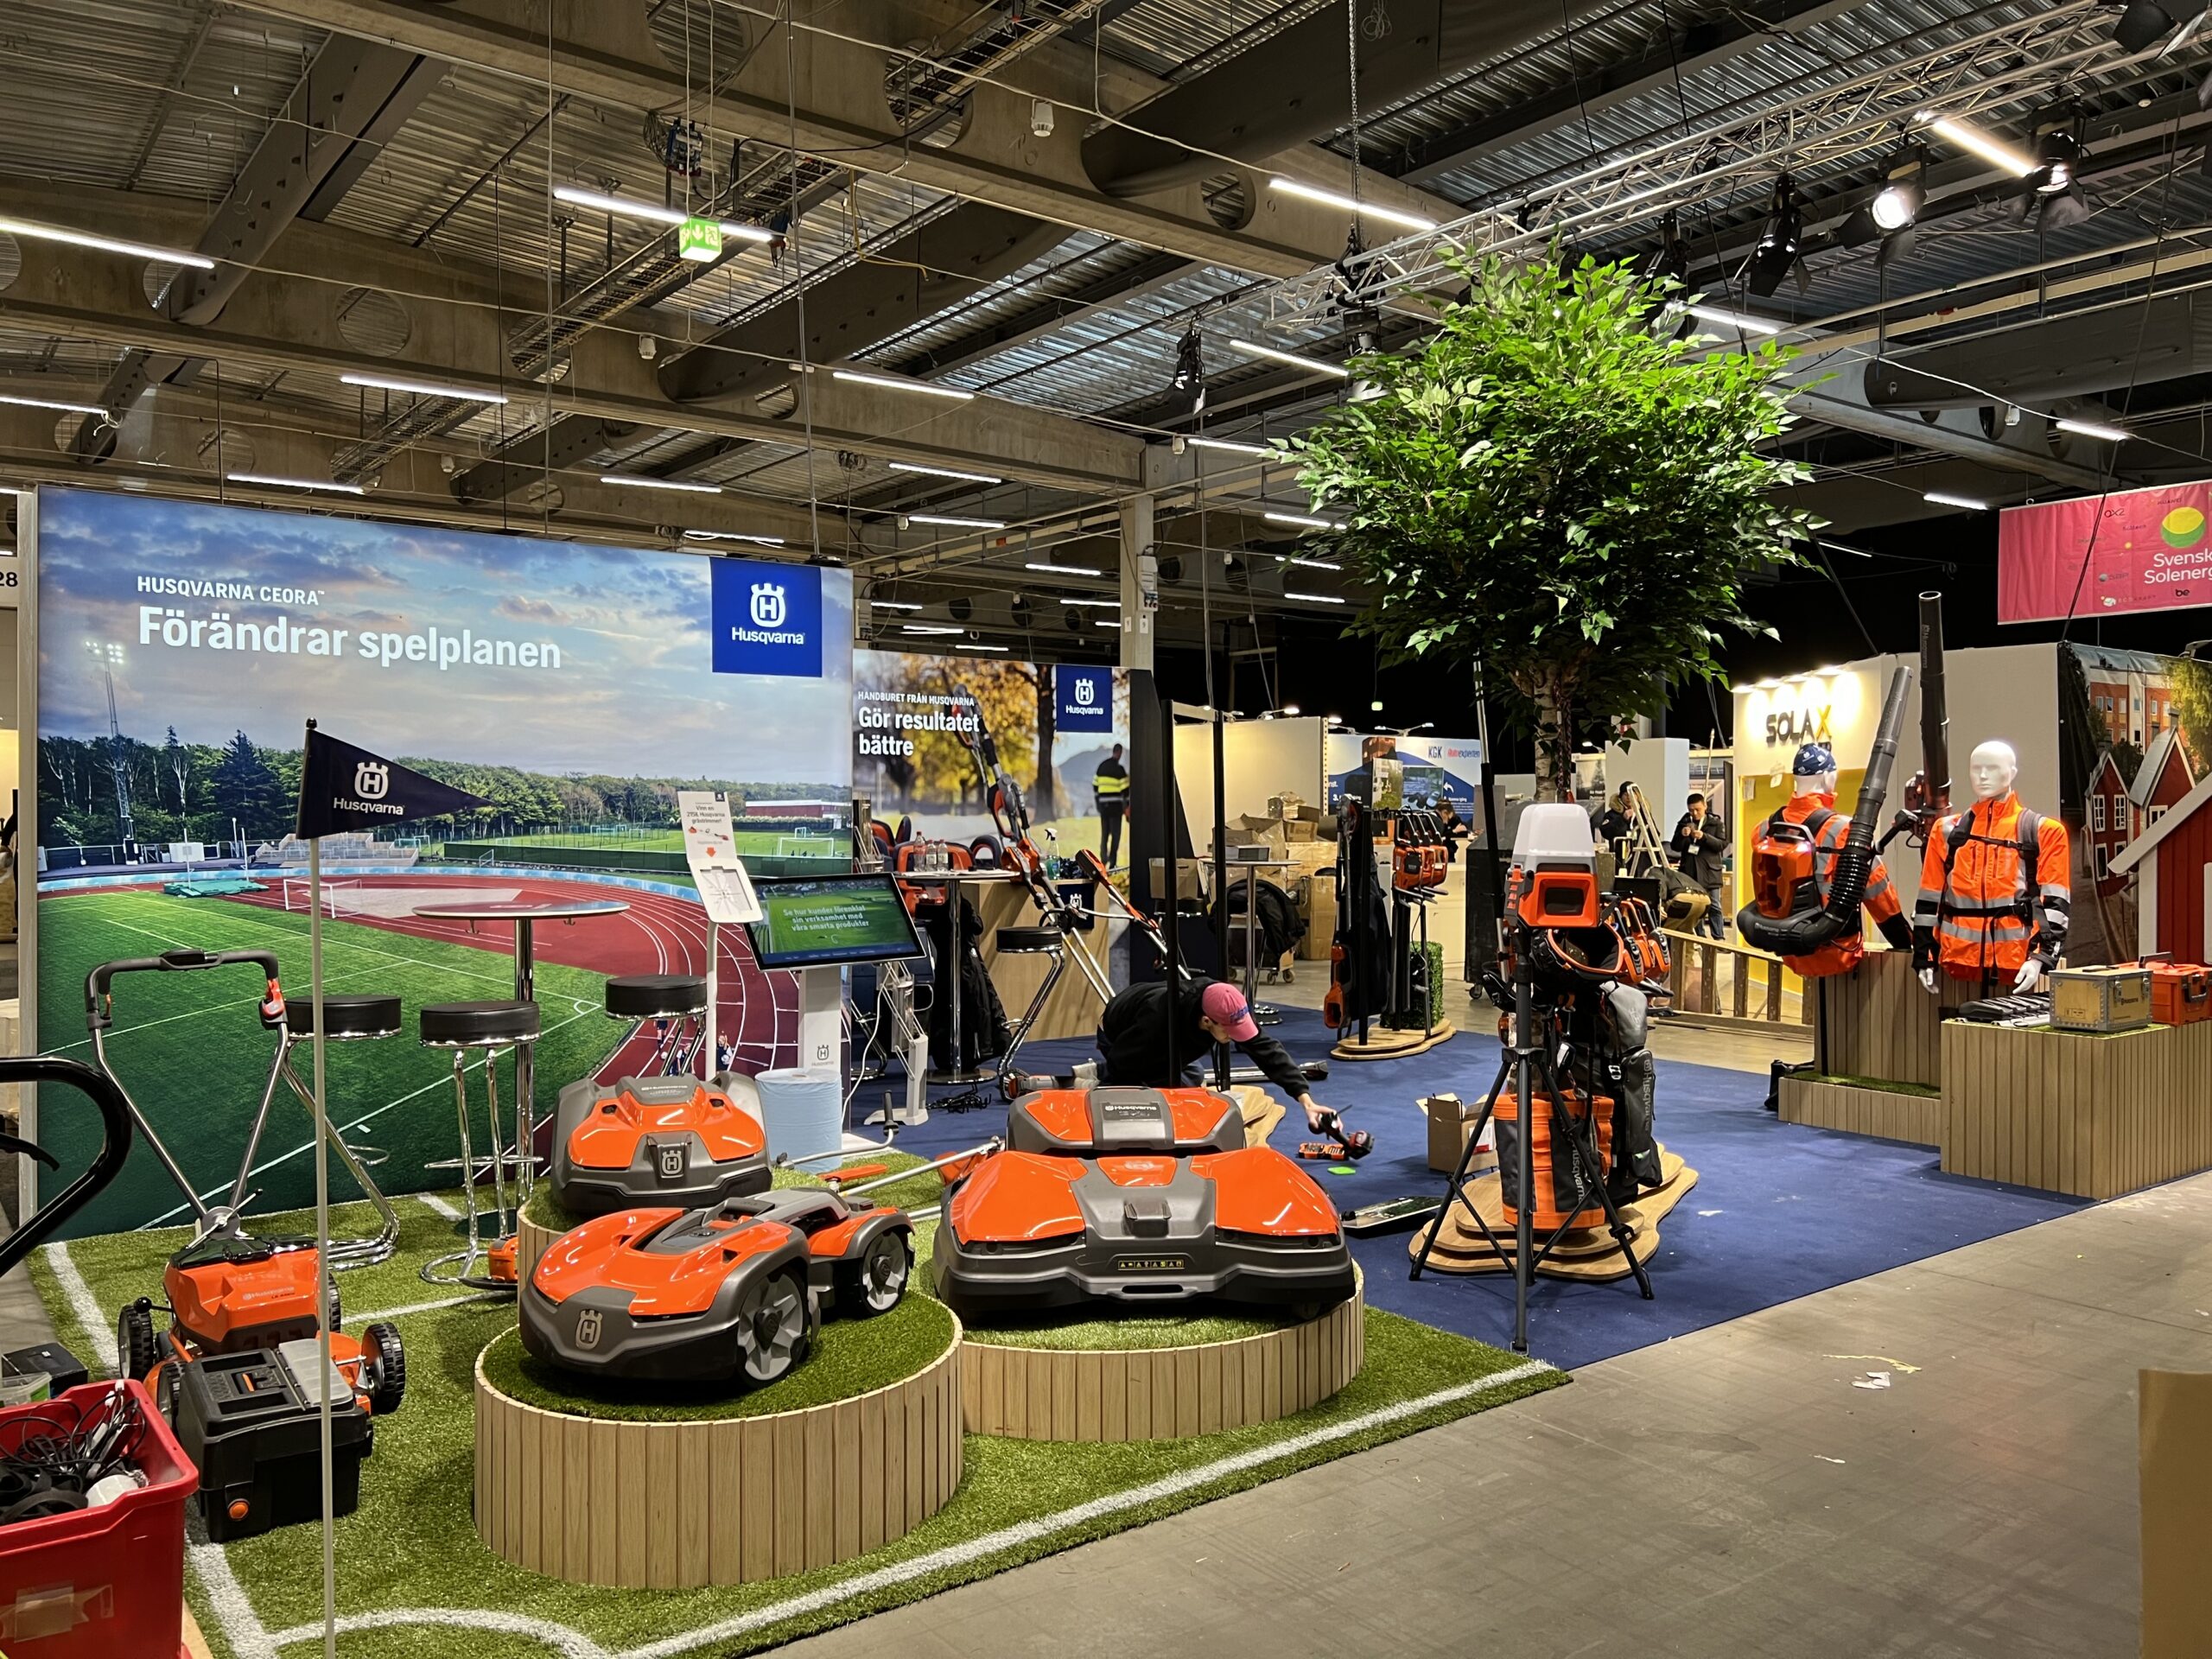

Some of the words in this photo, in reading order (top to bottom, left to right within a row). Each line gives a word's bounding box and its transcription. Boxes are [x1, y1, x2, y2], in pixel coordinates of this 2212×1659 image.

[137, 575, 255, 601] HUSQVARNA
[139, 605, 349, 657] Förändrar
[358, 626, 561, 671] spelplanen
[731, 626, 805, 645] Husqvarna
[857, 690, 905, 702] HANDBURET
[906, 692, 928, 704] FRÅN
[929, 695, 976, 707] HUSQVARNA
[858, 706, 891, 728] Gör
[895, 710, 980, 732] resultatet
[1065, 704, 1104, 715] Husqvarna
[1765, 704, 1833, 744] SOLAX
[859, 733, 914, 756] bättre
[1427, 746, 1443, 759] KGK
[333, 797, 404, 816] Husqvarna
[835, 919, 869, 930] produkter
[848, 912, 863, 920] med
